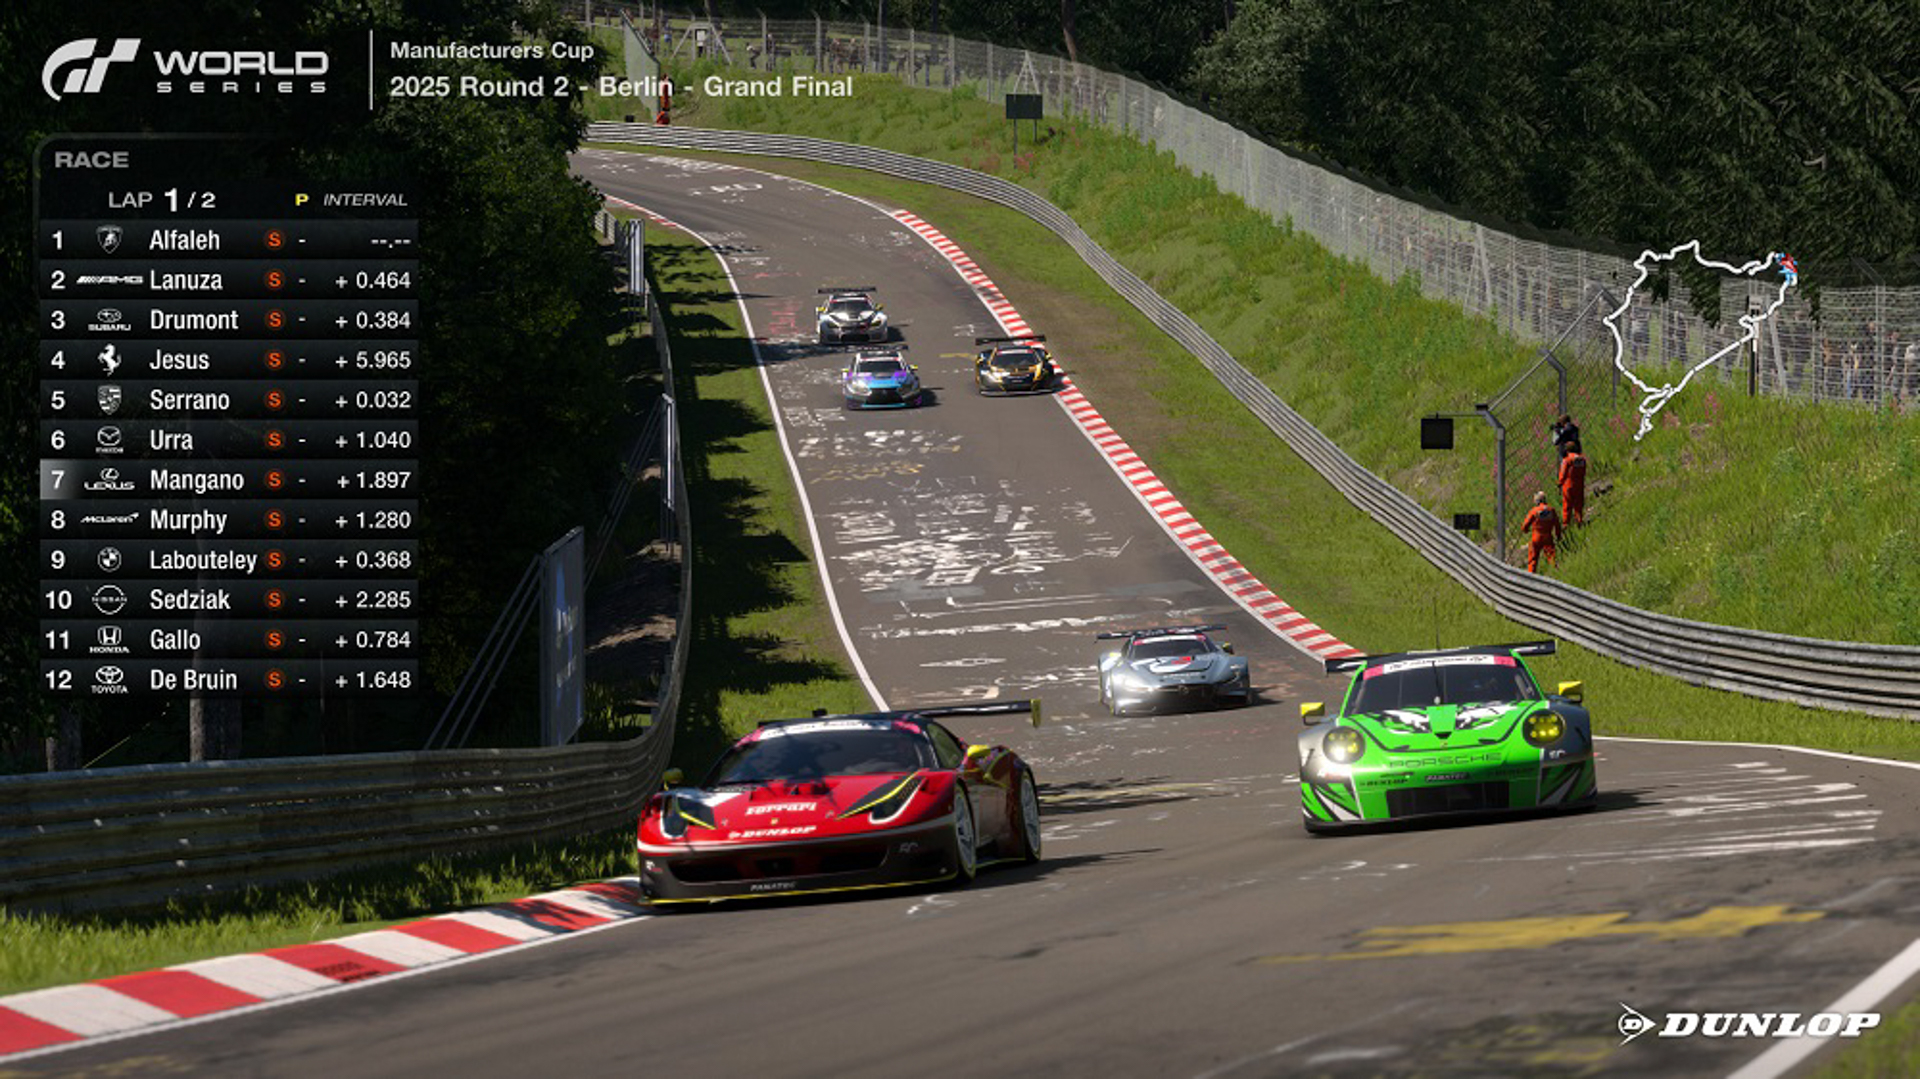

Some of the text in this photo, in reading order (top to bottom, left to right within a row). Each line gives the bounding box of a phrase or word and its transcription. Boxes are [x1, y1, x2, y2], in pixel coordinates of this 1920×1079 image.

[1388, 751, 1503, 769] PORSCHE
[740, 825, 818, 838] DUNLOP
[750, 881, 798, 892] FANATEC
